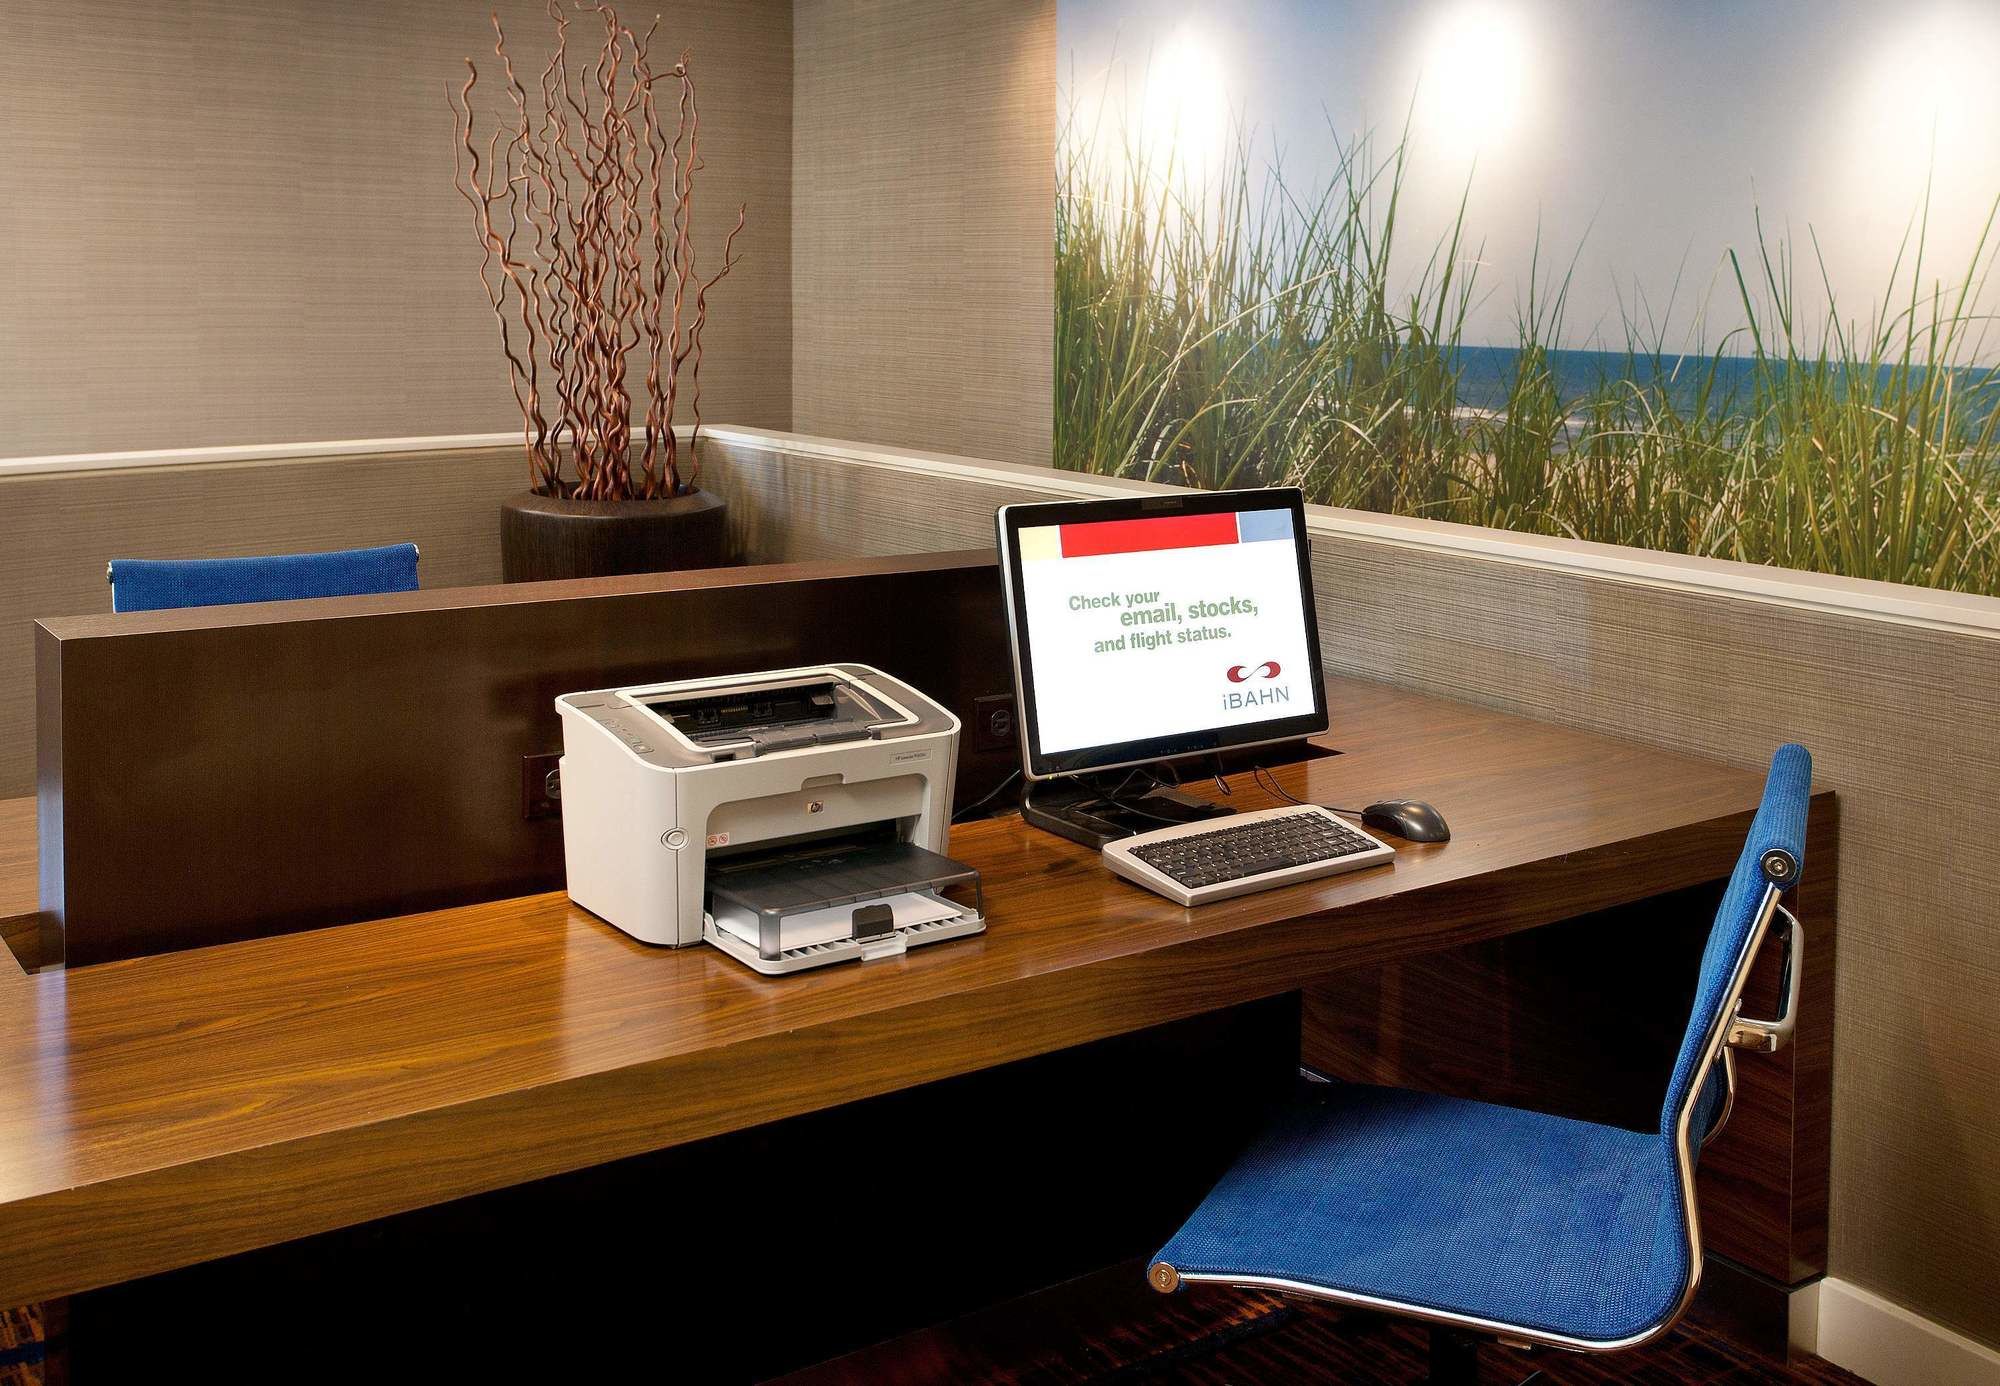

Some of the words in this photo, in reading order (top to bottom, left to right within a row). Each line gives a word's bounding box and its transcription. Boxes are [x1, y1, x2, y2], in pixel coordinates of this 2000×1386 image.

[1068, 592, 1121, 611] Check
[1125, 591, 1160, 608] your
[1120, 602, 1183, 627] email,
[1188, 596, 1259, 619] stocks,
[1094, 634, 1126, 653] and
[1130, 629, 1173, 650] flight
[1177, 625, 1232, 644] status.
[1222, 685, 1290, 711] iBAHN
